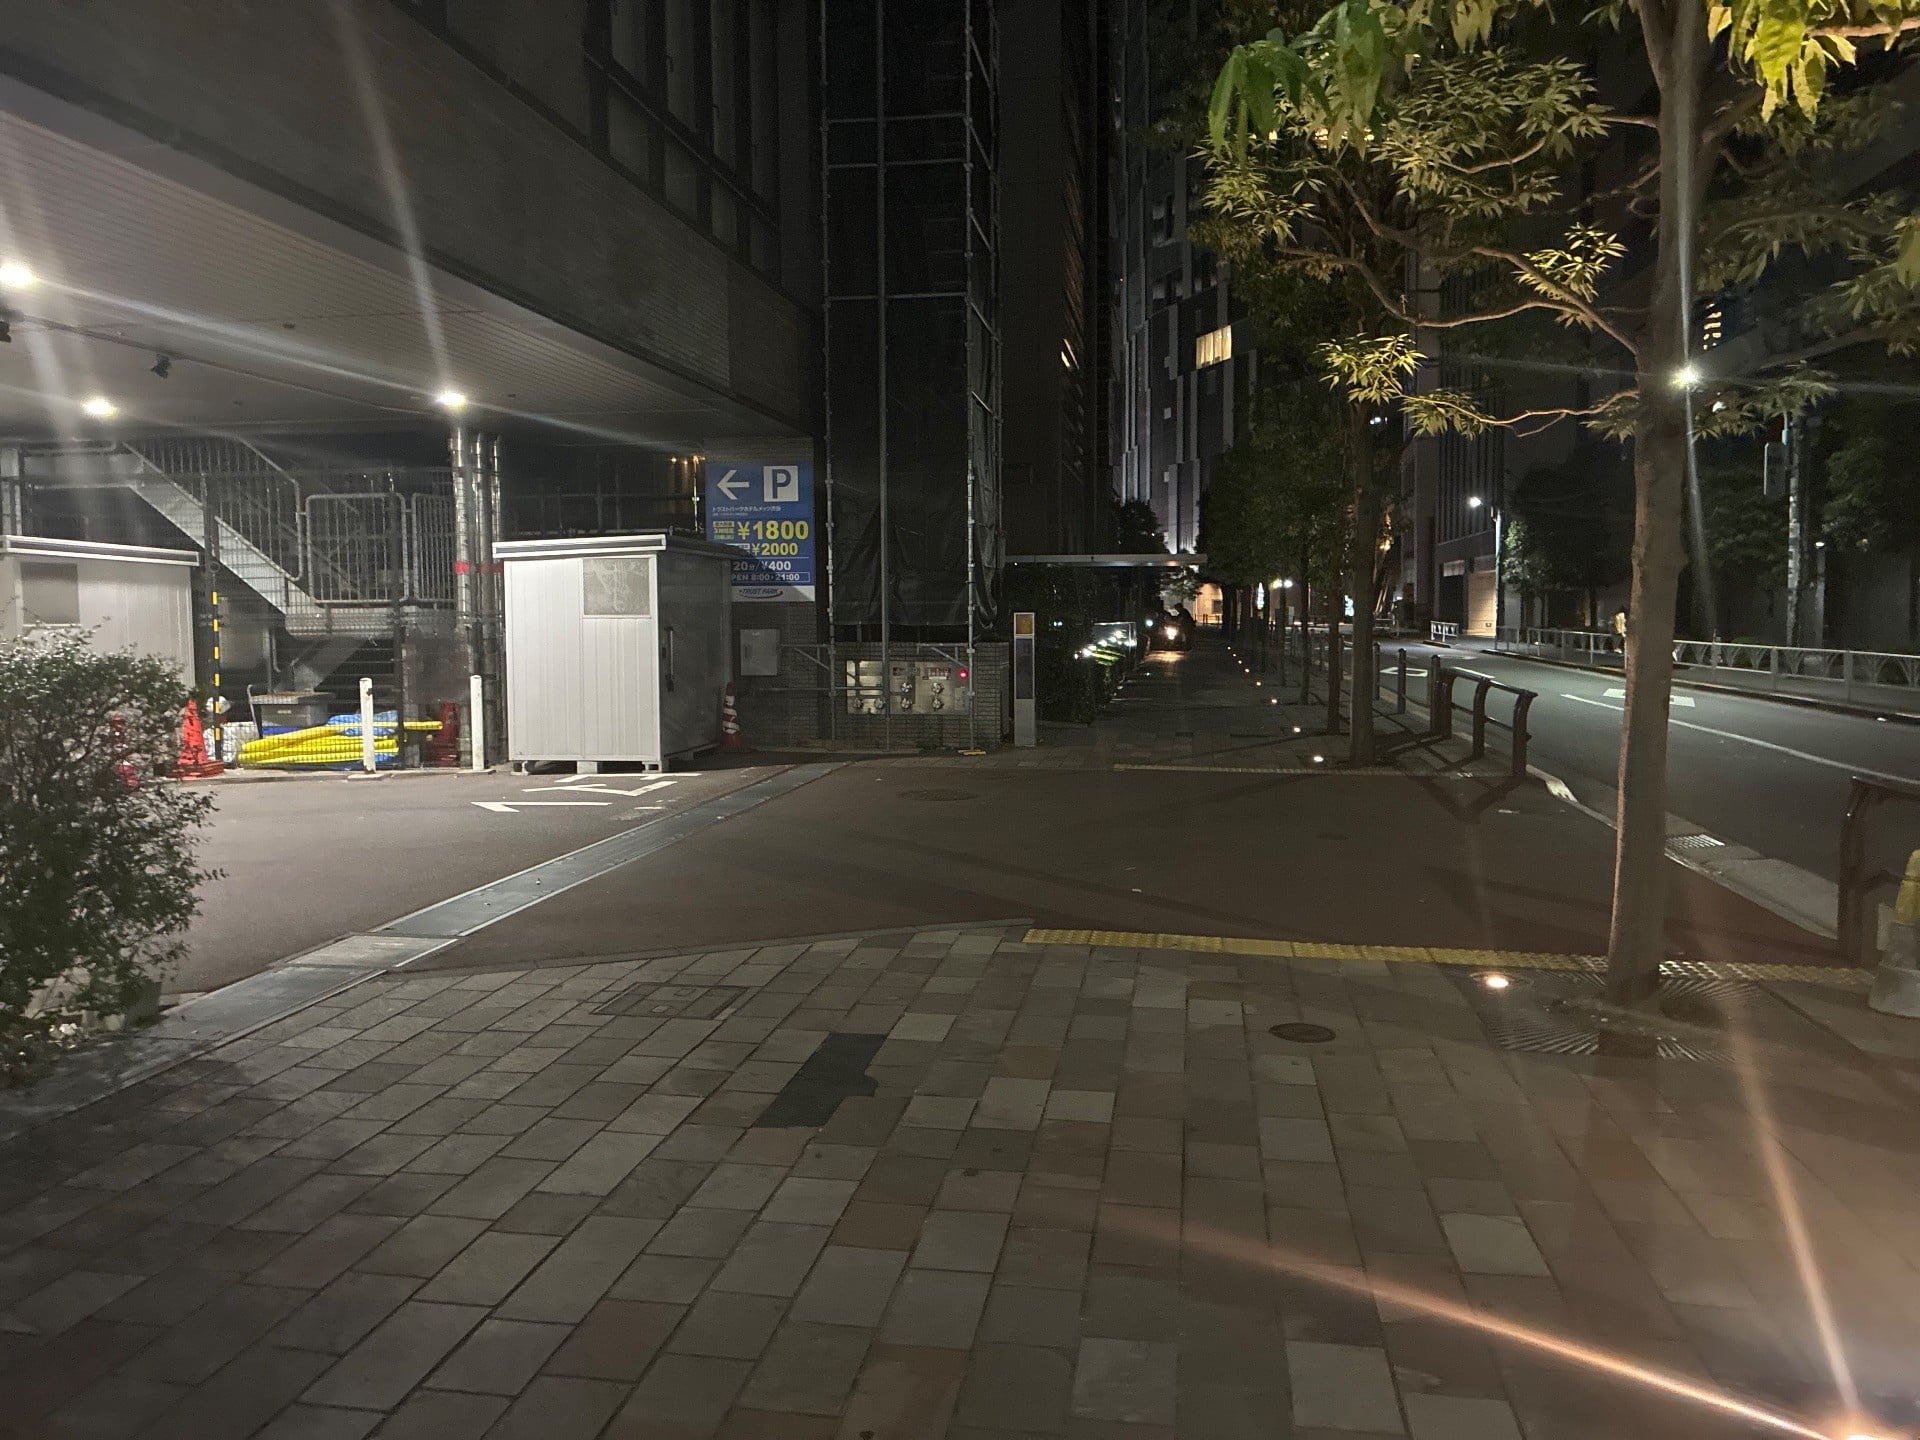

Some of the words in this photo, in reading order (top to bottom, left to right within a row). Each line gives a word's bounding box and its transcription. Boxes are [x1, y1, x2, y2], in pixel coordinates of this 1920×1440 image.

[772, 468, 792, 499] P
[737, 520, 809, 540] ¥1800
[751, 542, 799, 556] ¥2000
[732, 573, 749, 581] PEN
